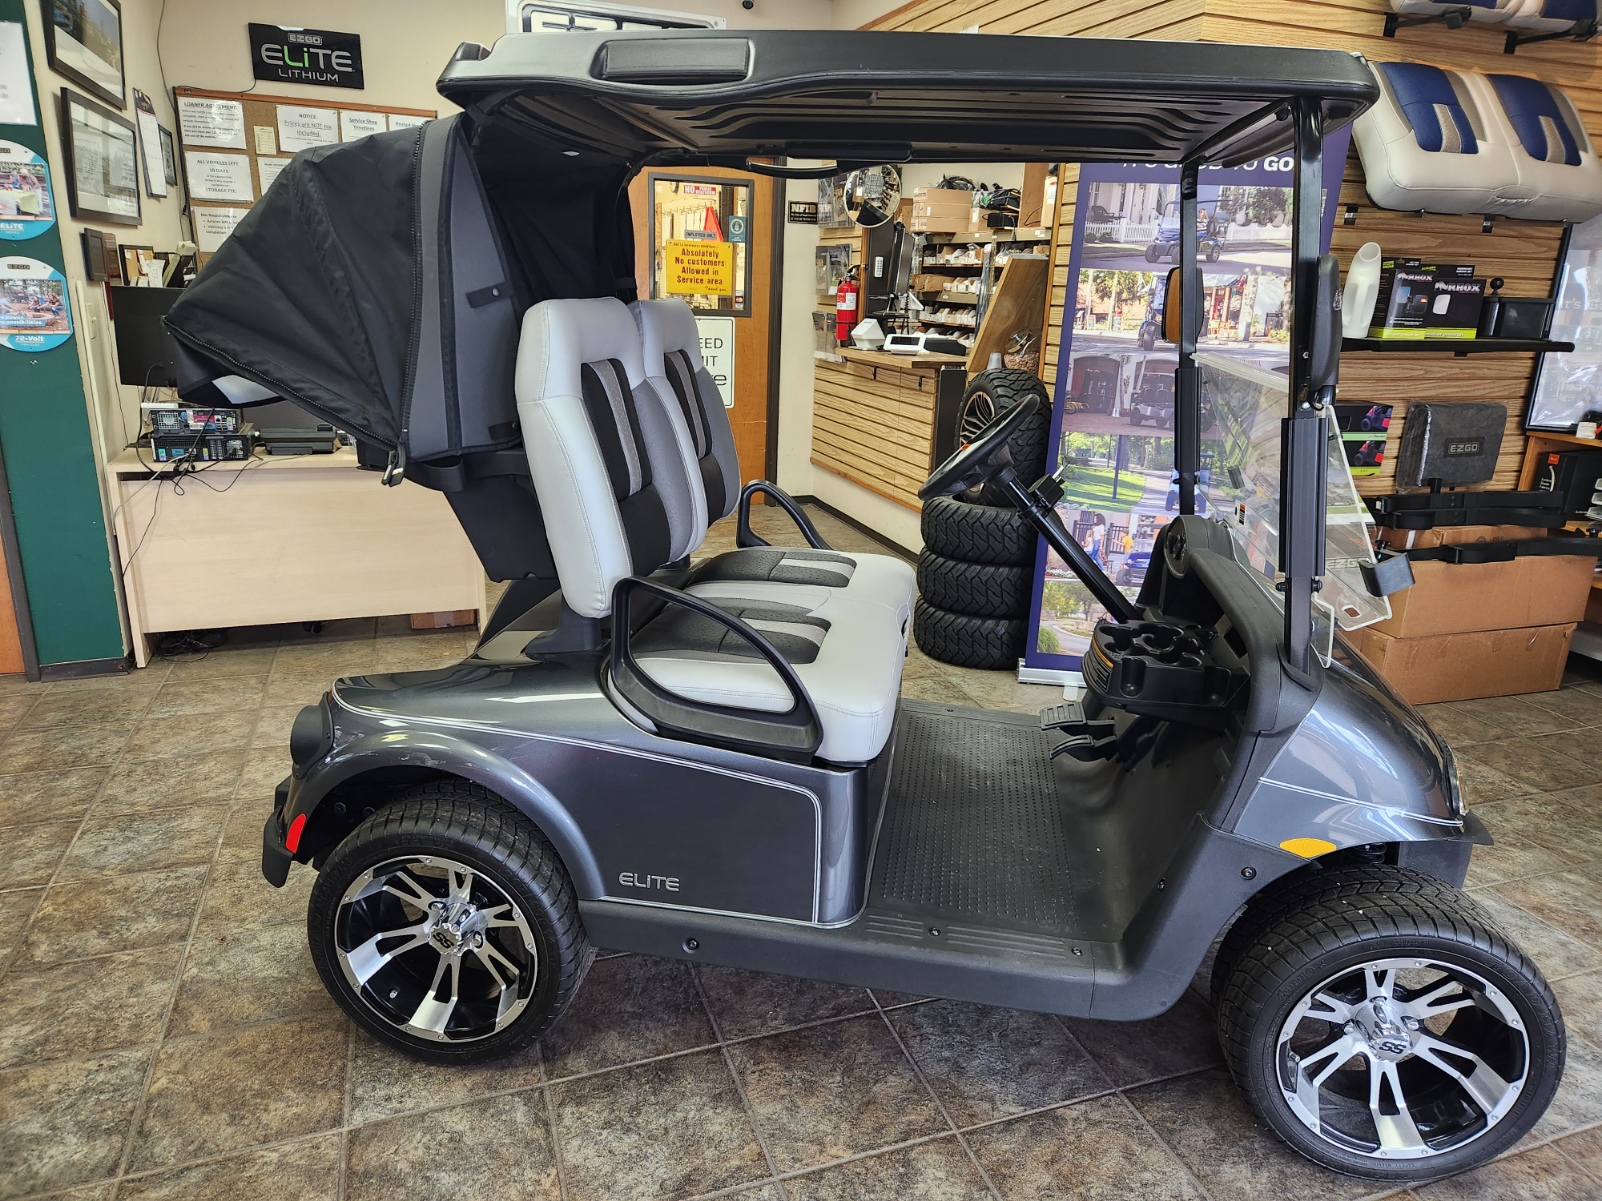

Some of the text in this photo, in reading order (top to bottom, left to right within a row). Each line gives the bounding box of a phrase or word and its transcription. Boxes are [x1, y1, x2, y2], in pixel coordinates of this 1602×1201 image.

[289, 34, 321, 44] EZGO
[278, 68, 339, 82] LITHIUM
[684, 185, 695, 194] NO
[790, 203, 817, 213] NFIB
[681, 248, 719, 259] Absolutely
[675, 256, 725, 267] No customers
[681, 266, 710, 275] Allowed
[676, 275, 704, 284] Service
[1450, 443, 1479, 453] EZGO
